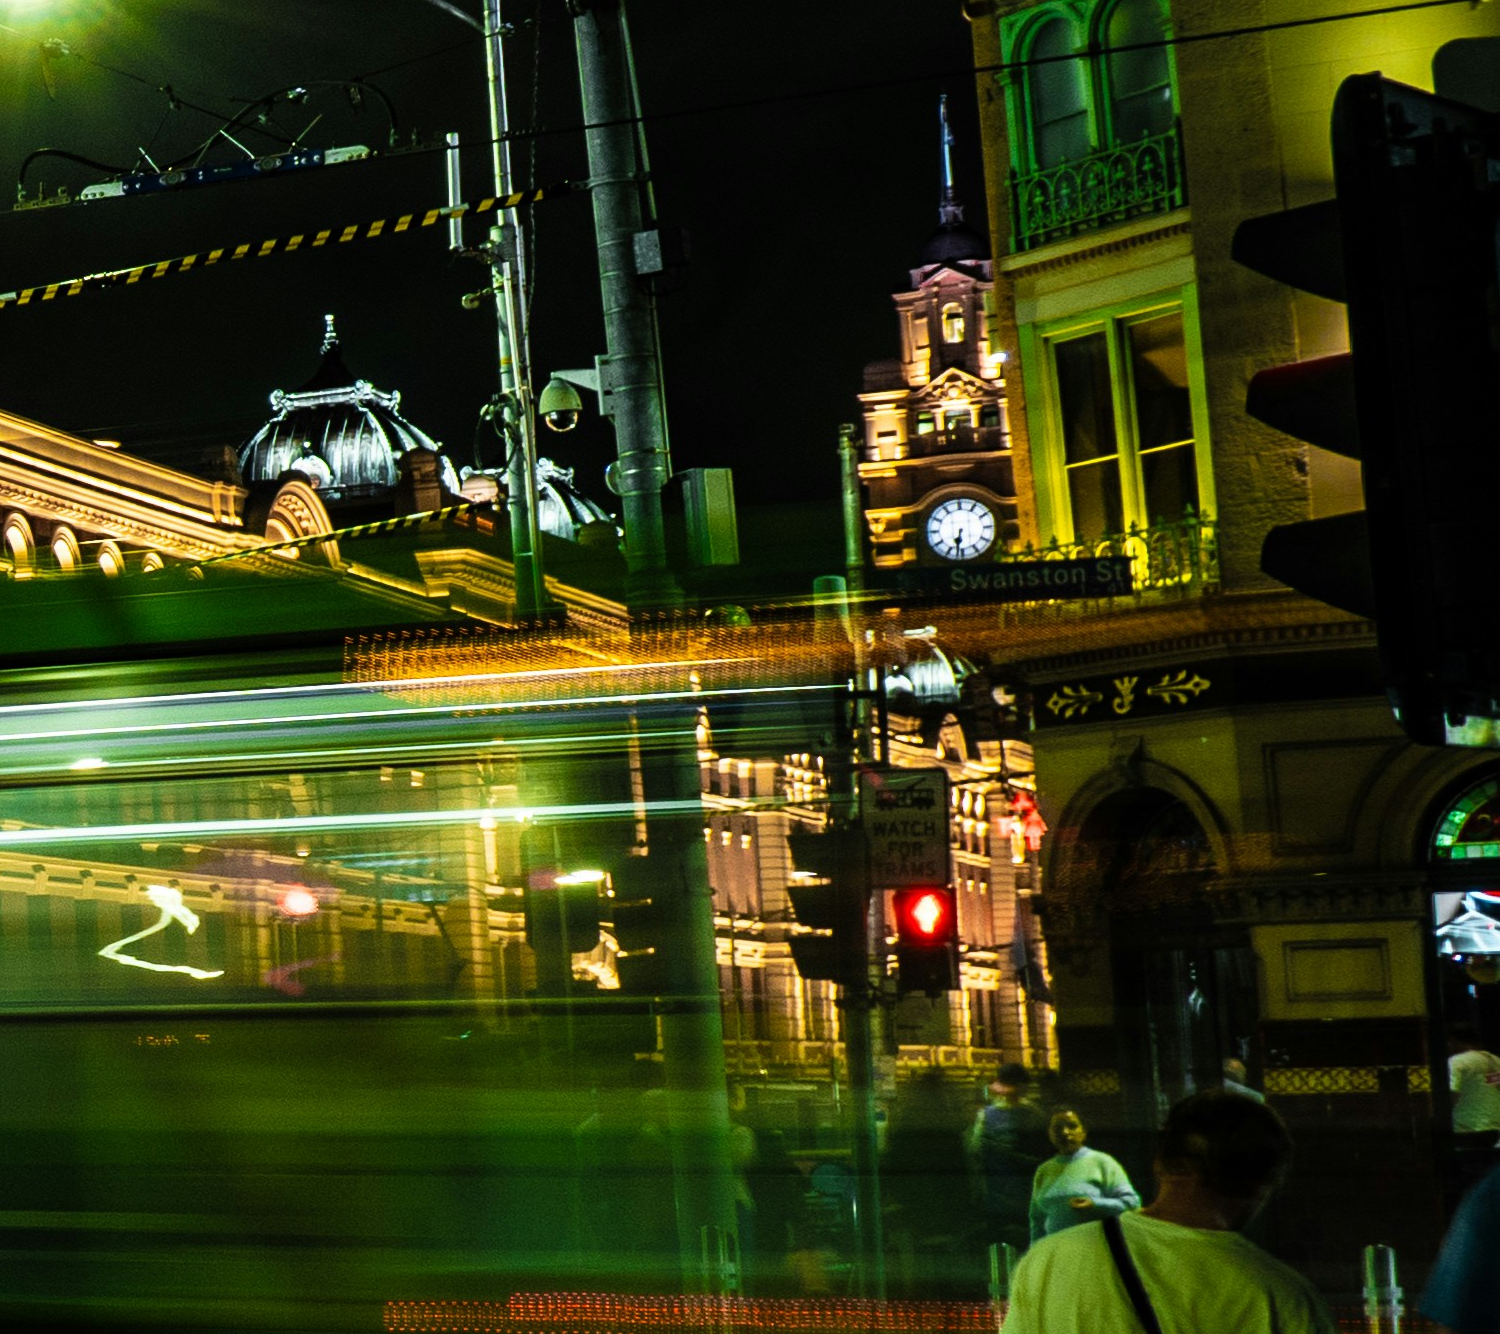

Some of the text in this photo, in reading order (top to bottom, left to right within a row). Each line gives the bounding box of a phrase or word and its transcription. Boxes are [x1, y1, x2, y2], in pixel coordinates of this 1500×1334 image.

[951, 559, 1124, 591] Swanston St
[873, 820, 937, 836] WATCH
[888, 840, 924, 857] FOR
